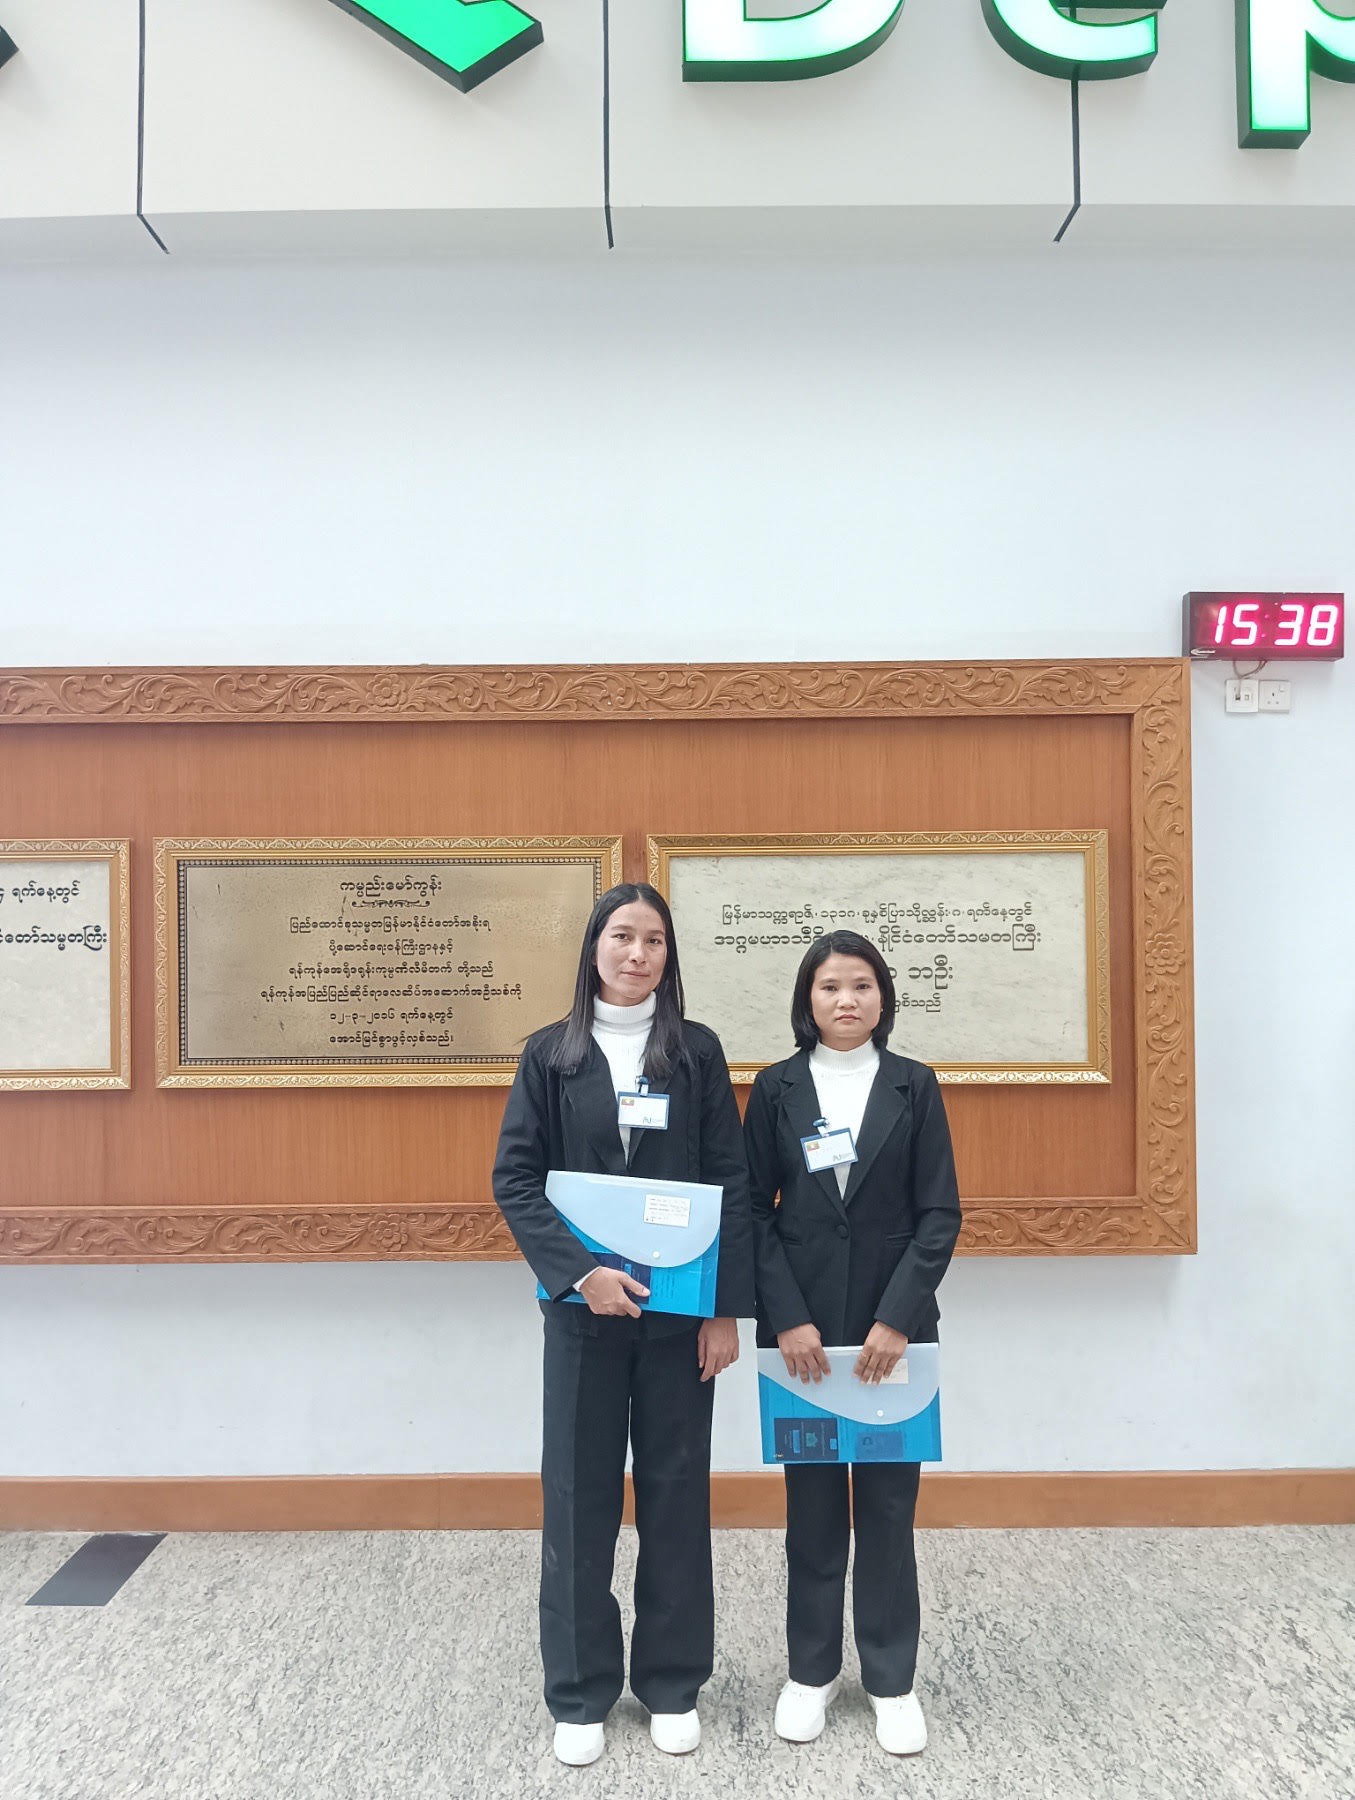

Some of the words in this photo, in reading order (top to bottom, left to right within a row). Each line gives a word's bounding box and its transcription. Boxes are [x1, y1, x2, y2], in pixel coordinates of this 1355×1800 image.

[340, 874, 442, 897] ကမ္ပည်းမော်ကွန်း
[400, 1007, 453, 1024] ရက်နေ့တွင်
